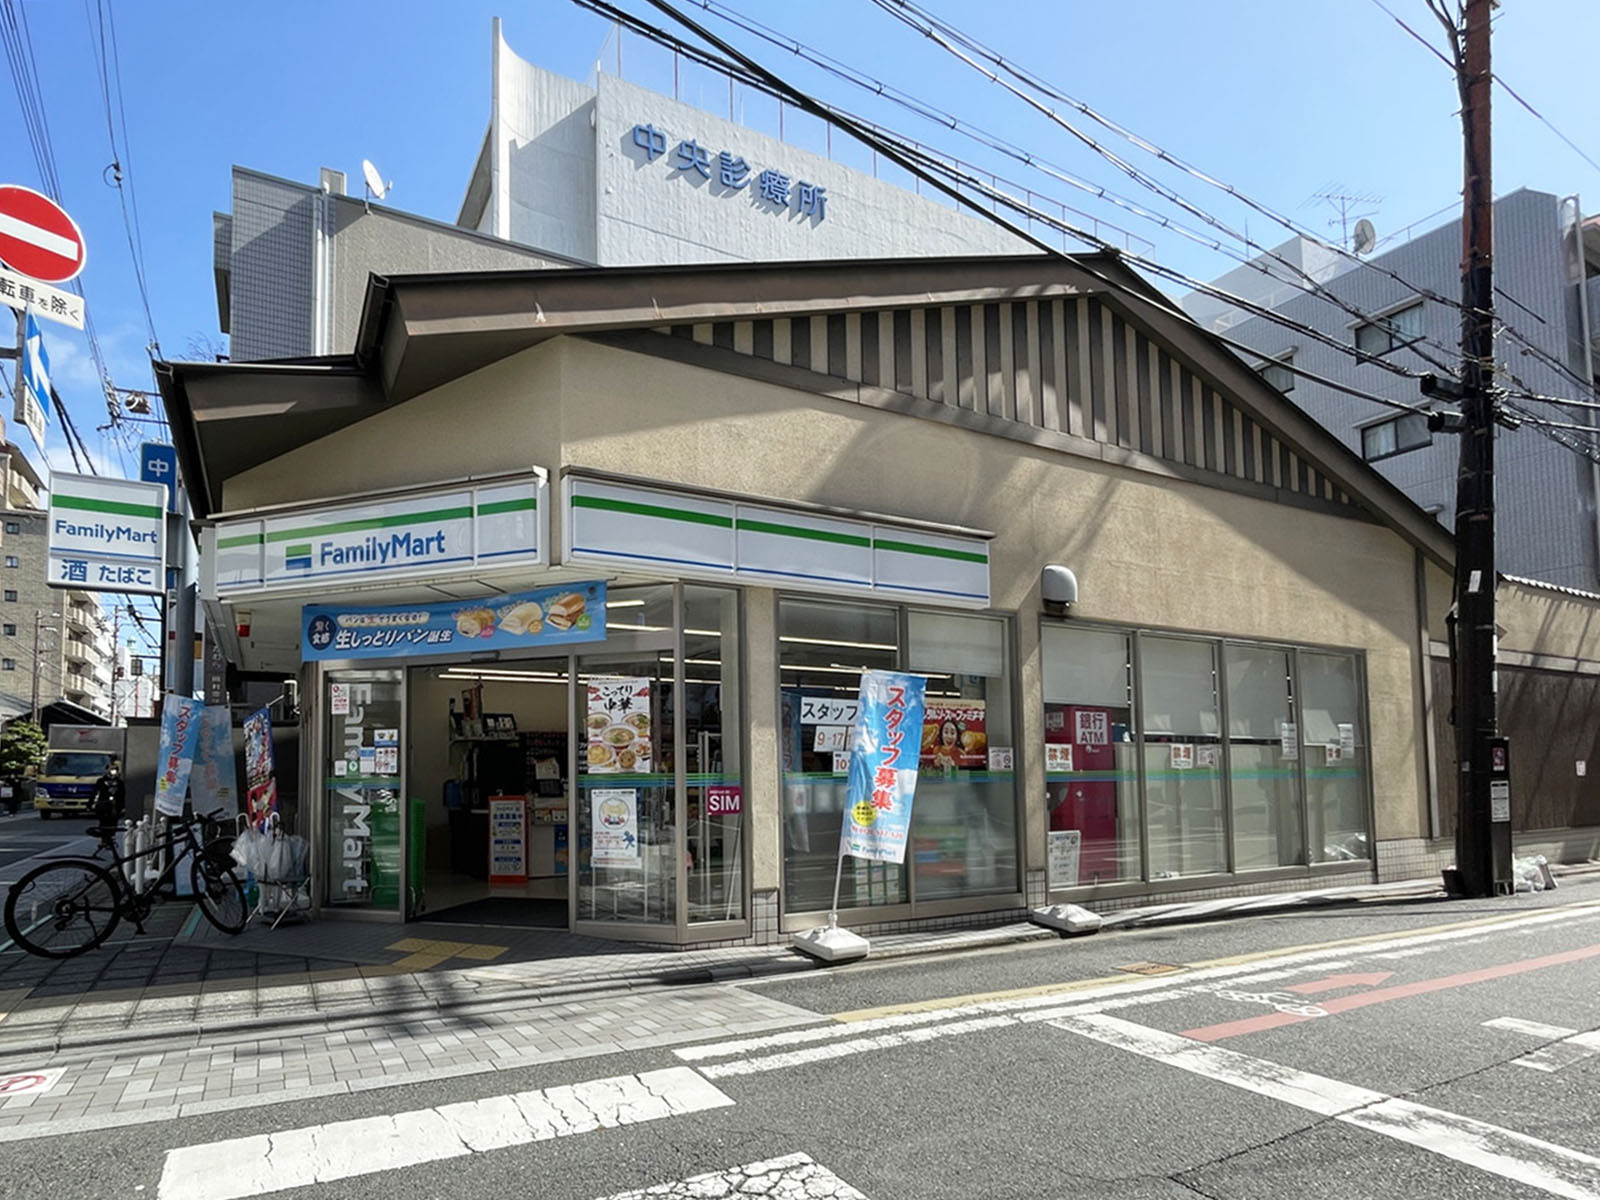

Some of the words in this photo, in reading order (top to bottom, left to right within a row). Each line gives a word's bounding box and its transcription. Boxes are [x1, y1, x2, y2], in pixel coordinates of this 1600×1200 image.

[633, 123, 828, 221] 中央診療所
[148, 459, 169, 477] 中
[55, 519, 158, 544] FamilyMart
[320, 530, 446, 567] FamilyMart
[61, 559, 88, 583] 酒
[98, 563, 153, 586] たばこ
[602, 685, 633, 697] こってり
[603, 696, 633, 714] 中華
[802, 702, 858, 721] スタッフ
[1080, 713, 1103, 729] 銀行
[1080, 731, 1104, 744] ATM
[870, 687, 906, 811] スタッフ募集
[709, 795, 740, 811] SIM
